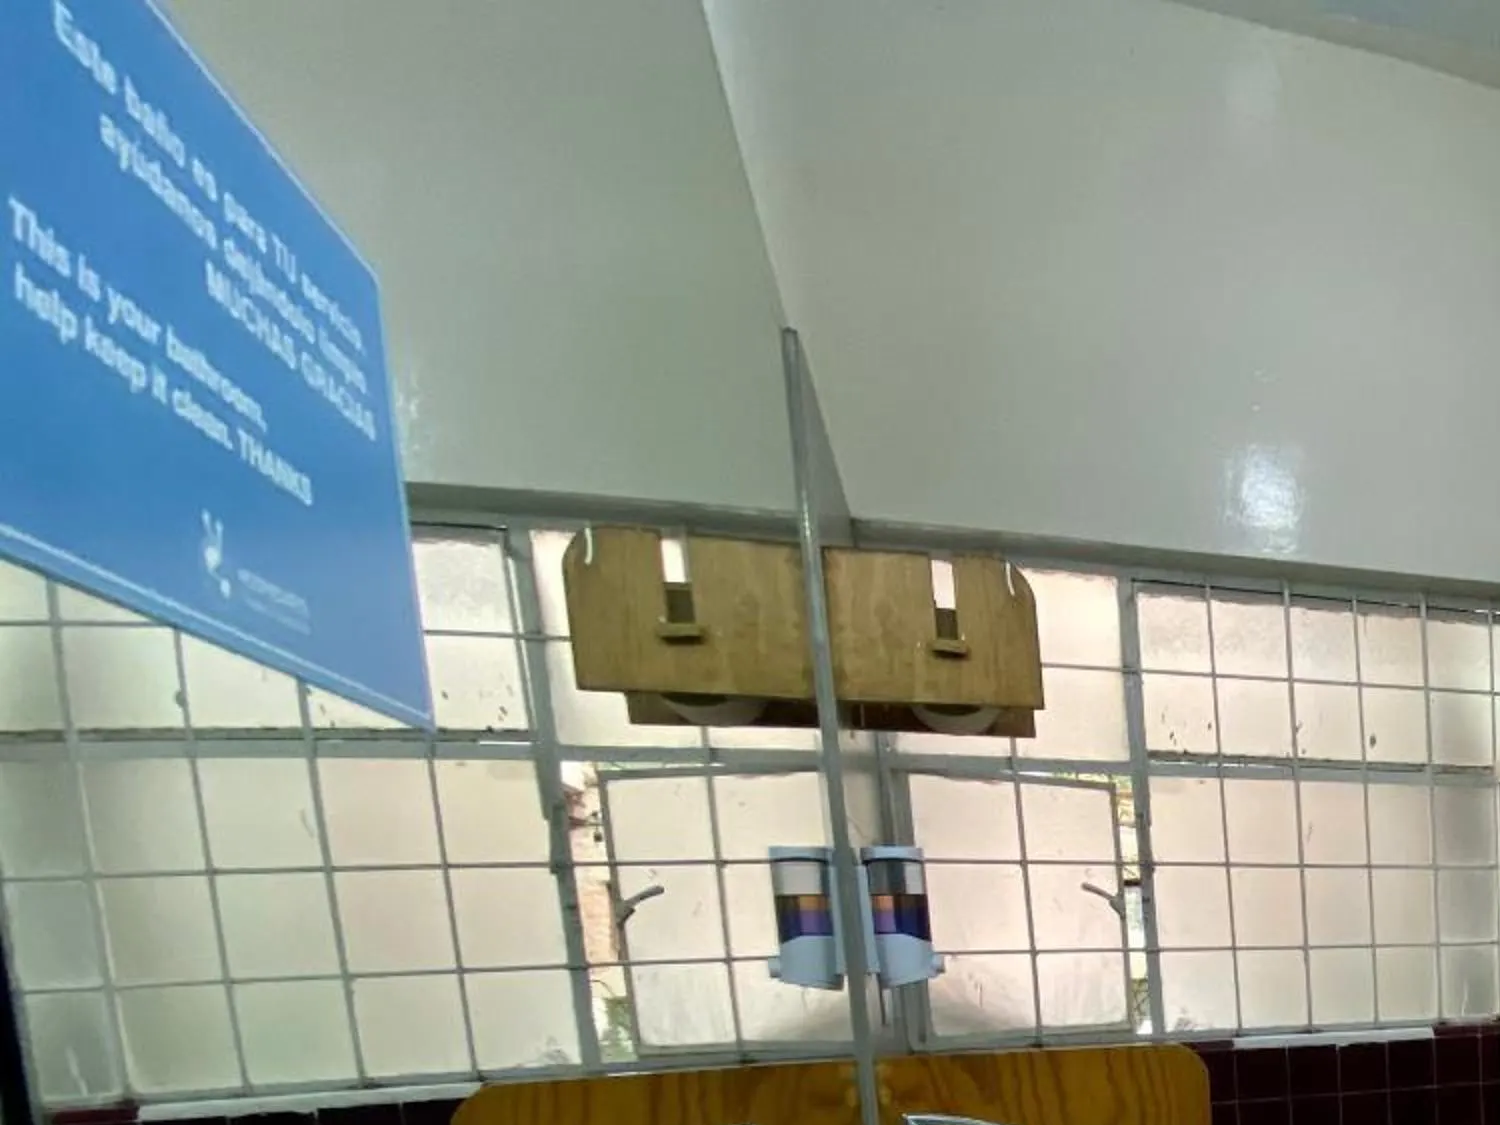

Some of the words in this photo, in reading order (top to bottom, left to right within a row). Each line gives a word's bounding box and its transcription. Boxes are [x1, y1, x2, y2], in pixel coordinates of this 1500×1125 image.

[54, 0, 117, 95] Este
[192, 157, 217, 202] es
[224, 191, 266, 254] para
[272, 233, 296, 284] TU
[8, 195, 71, 278] This
[78, 254, 100, 302] is
[105, 285, 161, 344] your
[207, 261, 297, 370] MUCHAS
[15, 263, 77, 345] help
[85, 315, 147, 393] keep
[152, 364, 167, 405] it
[237, 428, 312, 506] THANKS
